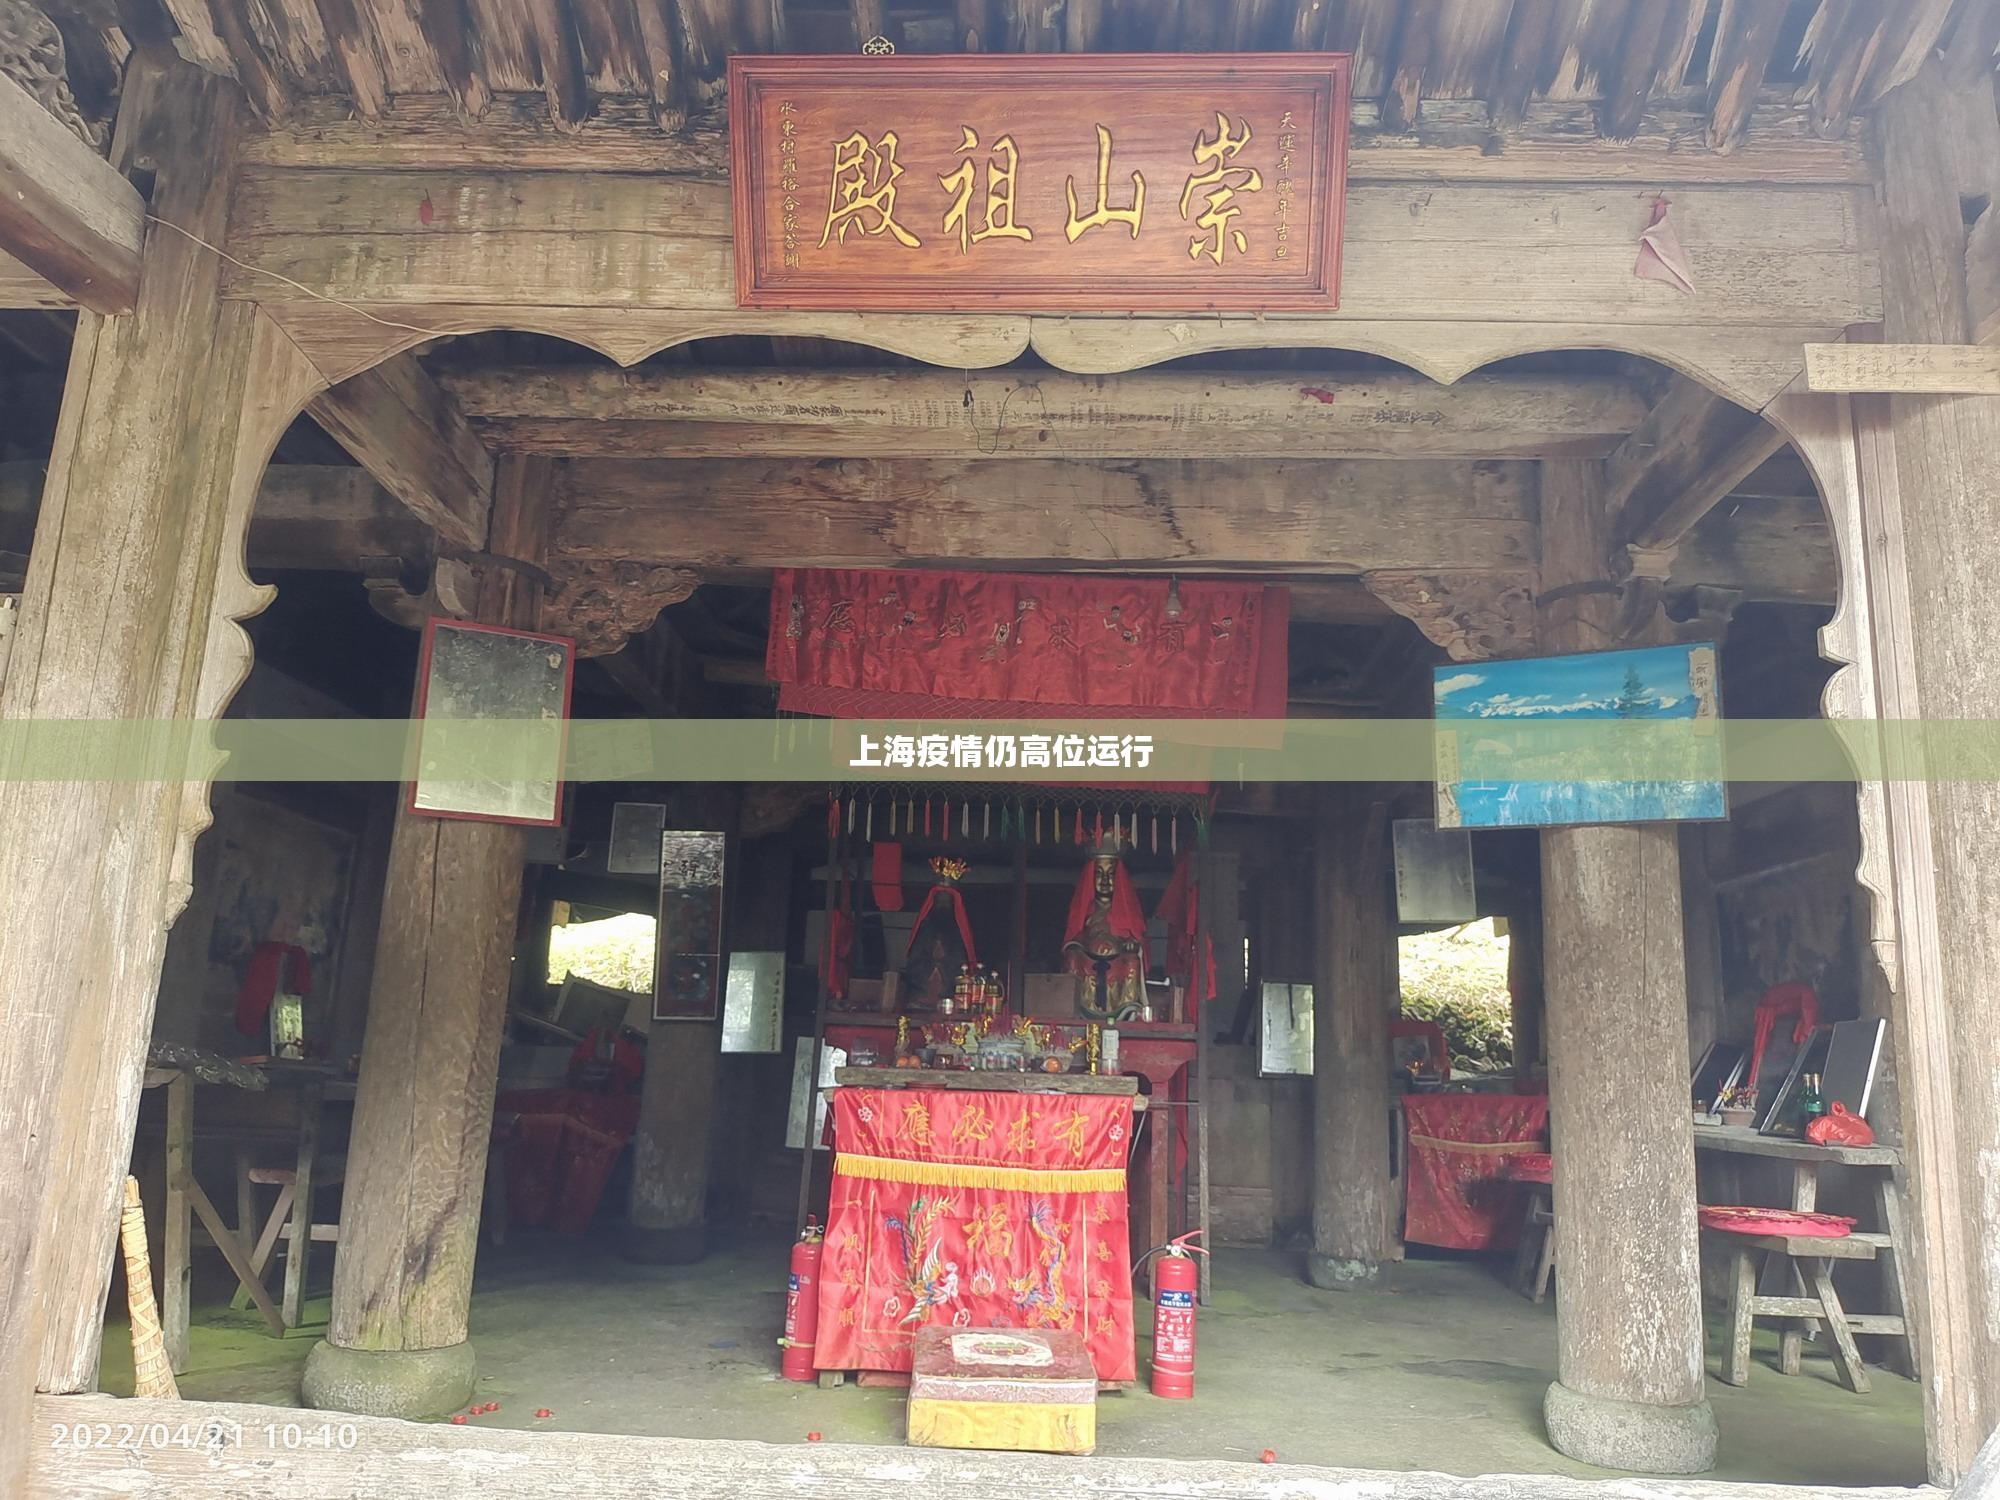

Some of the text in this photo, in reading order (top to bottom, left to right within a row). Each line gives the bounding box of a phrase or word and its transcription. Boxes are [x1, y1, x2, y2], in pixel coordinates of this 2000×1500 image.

[818, 110, 1265, 266] 崇山祖殿
[962, 1202, 1014, 1257] 福
